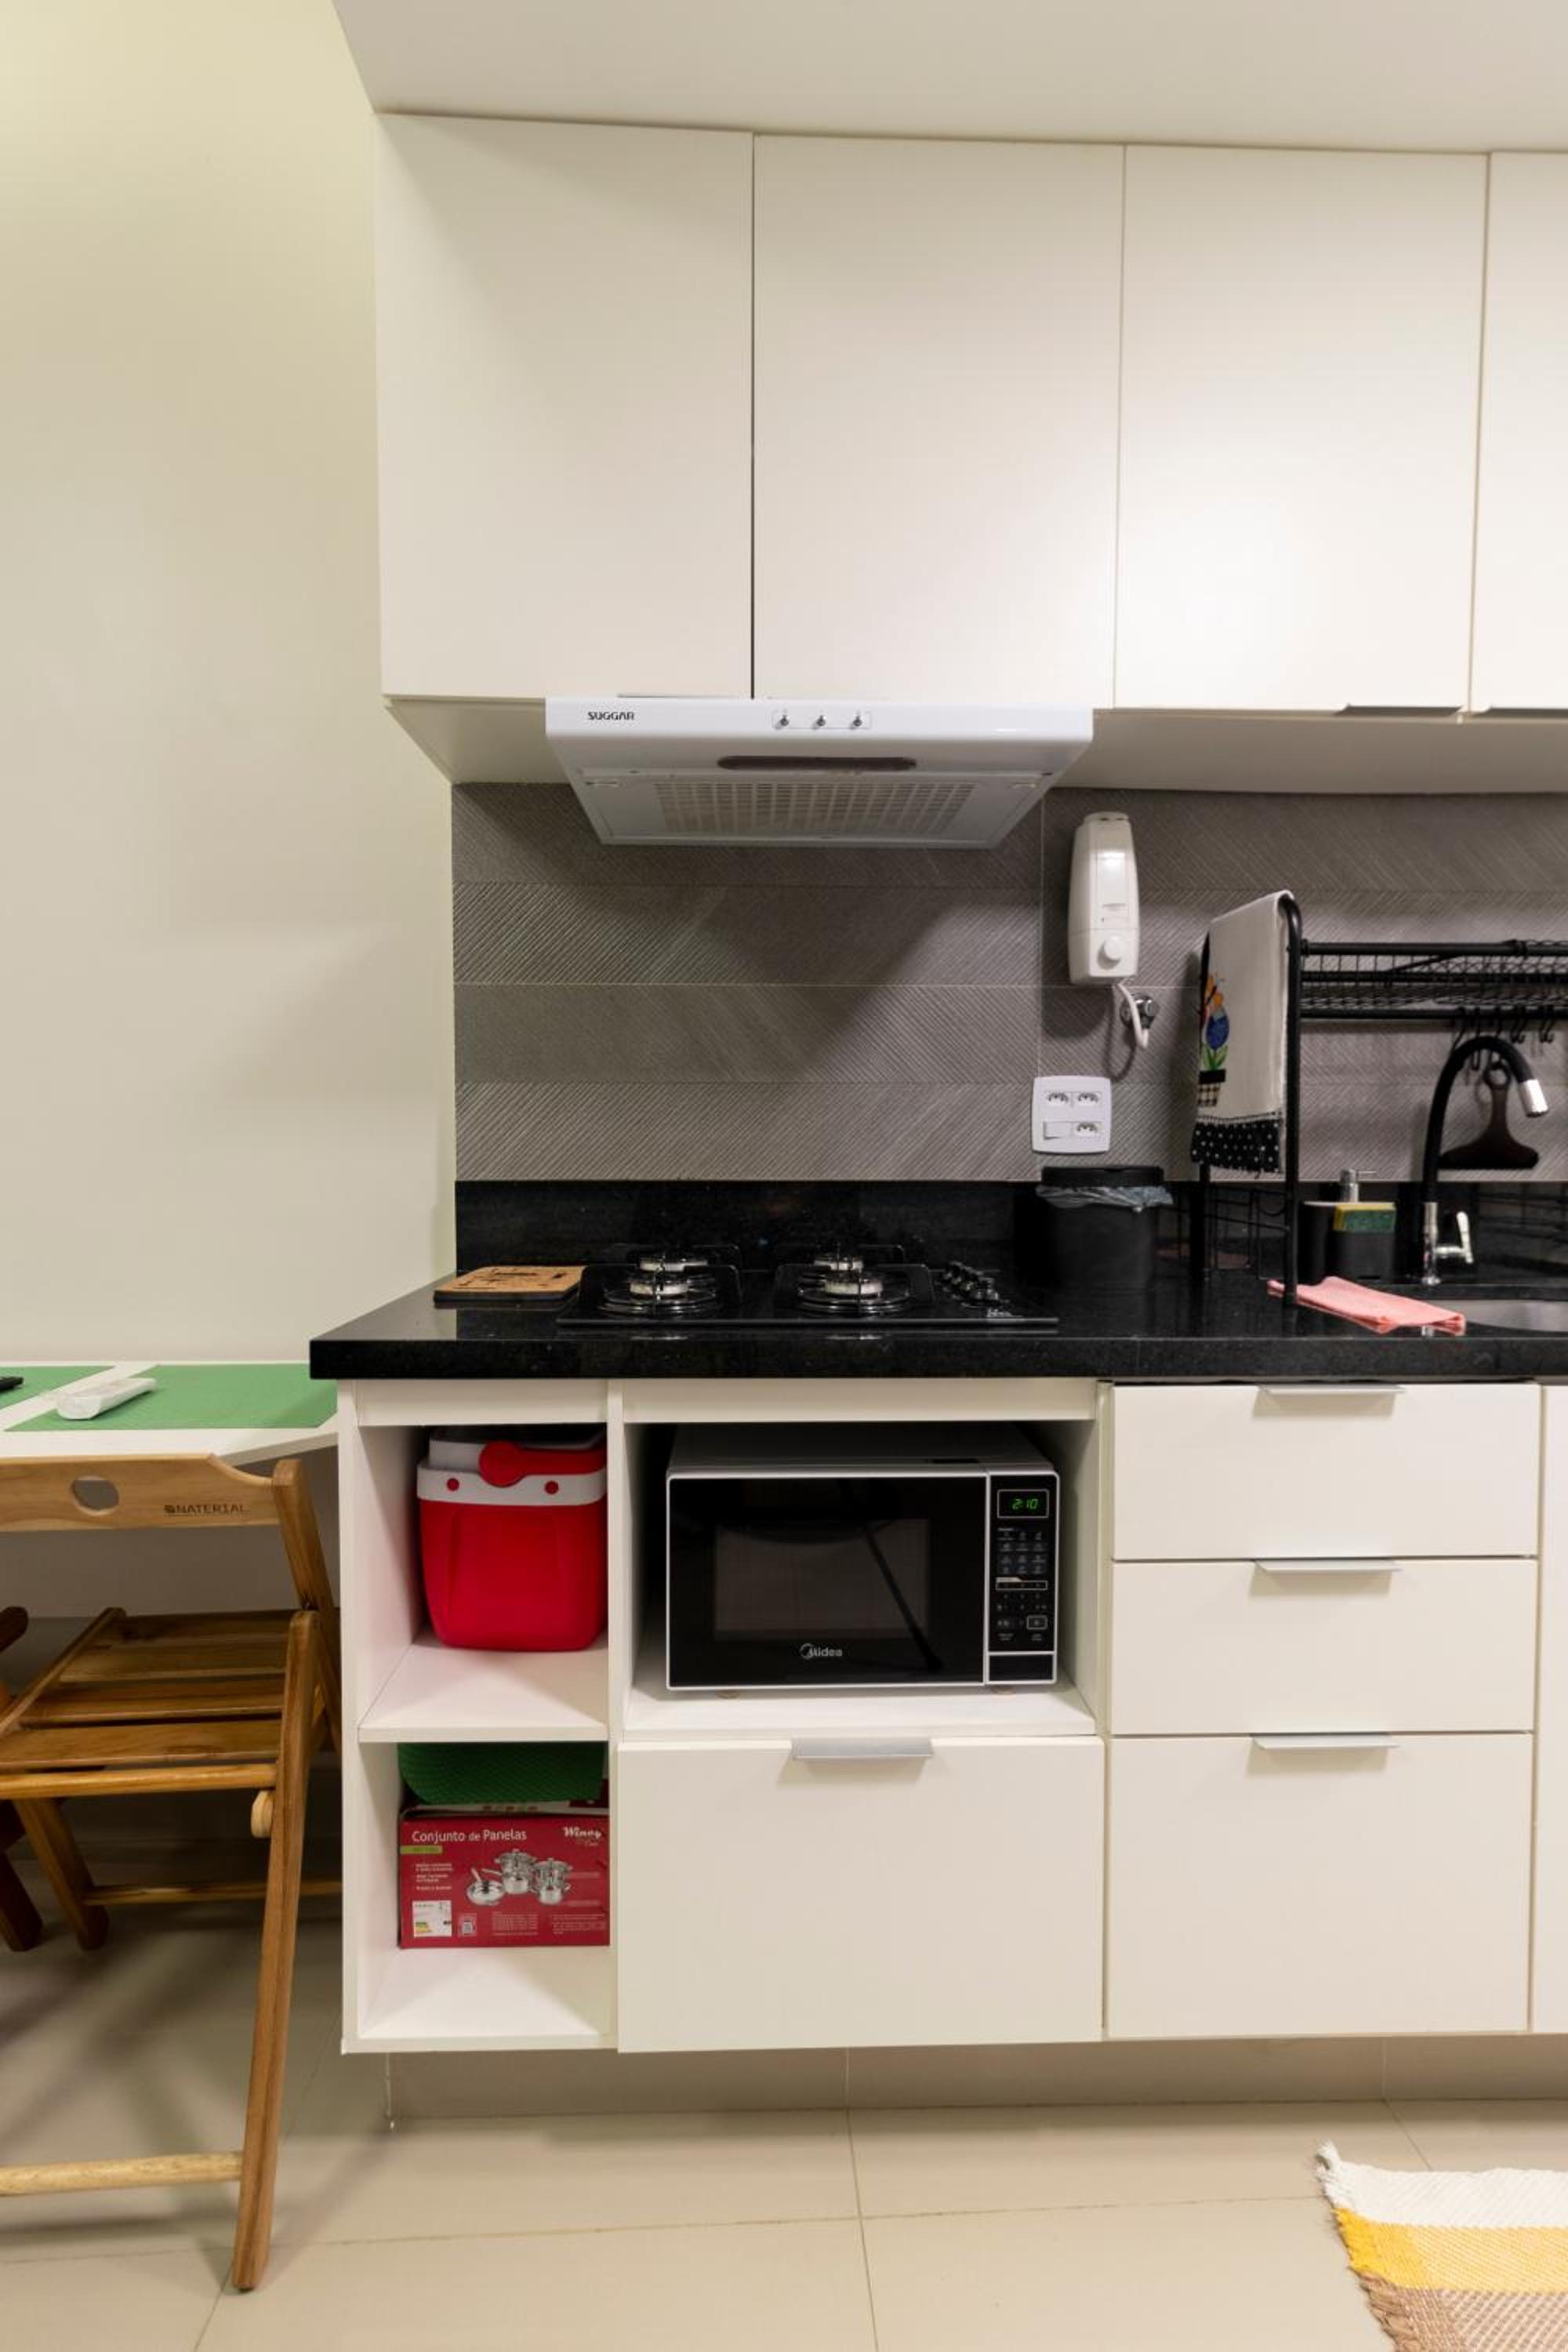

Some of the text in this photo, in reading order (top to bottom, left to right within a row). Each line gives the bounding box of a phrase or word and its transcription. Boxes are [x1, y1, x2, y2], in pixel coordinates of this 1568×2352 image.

[587, 711, 635, 720] SUGGAR
[176, 1504, 250, 1514] NATERIAL
[1011, 1497, 1039, 1510] 2:10
[800, 1642, 843, 1660] Midea
[412, 1828, 528, 1844] Conjunto de Panelas
